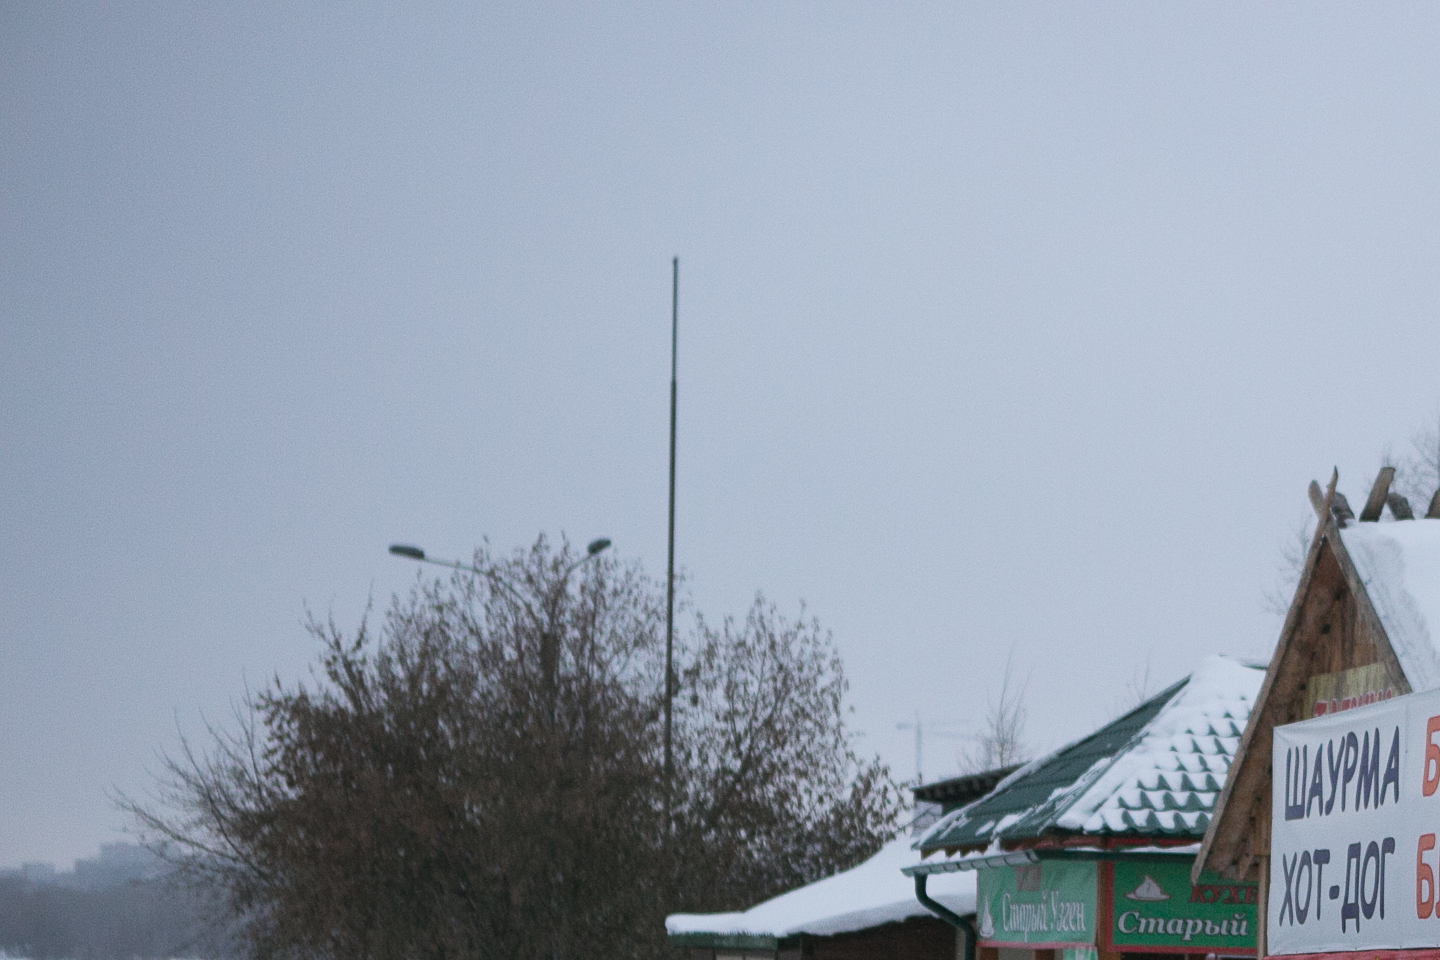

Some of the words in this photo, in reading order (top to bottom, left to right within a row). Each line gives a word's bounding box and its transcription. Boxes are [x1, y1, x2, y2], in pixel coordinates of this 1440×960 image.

[1284, 725, 1401, 821] ШАУРМА
[1002, 890, 1048, 943] Старый
[1279, 836, 1396, 934] ХОТ-ДОГ
[1117, 911, 1248, 941] Старый
